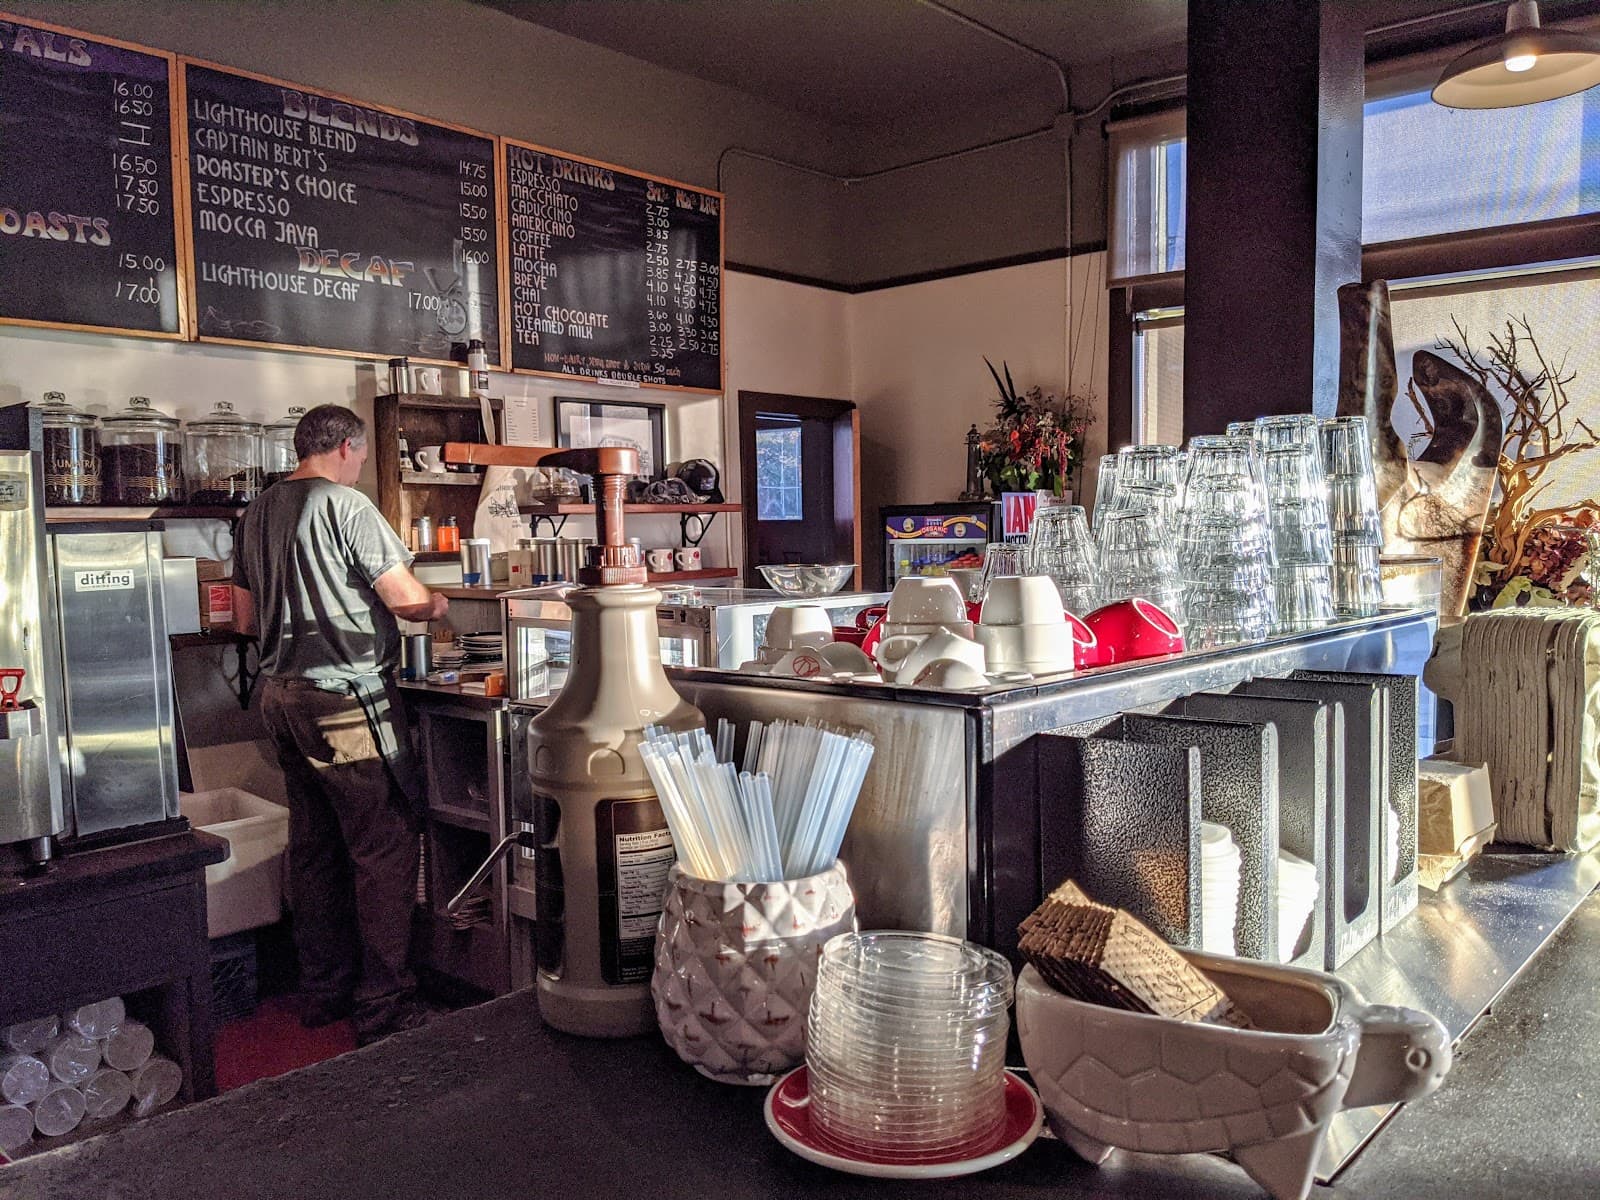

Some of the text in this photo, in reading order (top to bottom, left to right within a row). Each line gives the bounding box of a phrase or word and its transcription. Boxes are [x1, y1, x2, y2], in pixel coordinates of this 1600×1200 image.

[113, 79, 153, 98] 16.00
[114, 98, 153, 116] 16.50
[194, 99, 357, 153] LIGHTHOUSE BLEND
[281, 89, 419, 147] BLENDS
[195, 127, 328, 173] CAPTAIN BERT'S
[113, 153, 157, 175] 16.50
[460, 159, 487, 179] 14.75
[510, 146, 615, 192] HOT DRINKS
[196, 153, 357, 205] ROASTER'S CHOICE
[460, 181, 488, 198] 15.00
[511, 168, 560, 193] ESPRESSO
[197, 182, 290, 217] ESPRESSO
[511, 183, 578, 211] MACCHIATO
[460, 202, 487, 220] 15.50
[511, 198, 573, 224] CAPUCCINO
[647, 214, 670, 228] 3.00
[199, 209, 319, 248] MOCCA JAVA
[461, 226, 488, 242] 15.50
[511, 213, 576, 239] AMERICANO
[646, 227, 670, 240] 3.85
[512, 228, 551, 248] COFFEE
[119, 252, 165, 271] 15.00
[513, 242, 546, 261] LATTE
[295, 246, 415, 288] DECAF
[513, 256, 557, 278] MOCHA
[201, 262, 361, 302] LIGHTHOUSE DECAF
[514, 272, 547, 291] BREVE
[647, 266, 669, 280] 3.85
[699, 275, 719, 290] 4.50
[115, 277, 161, 304] 17.00
[408, 291, 439, 311] 17.00
[514, 286, 540, 302] CHAI
[646, 294, 666, 307] 4.10
[514, 301, 609, 328] HOT CHOCOLATE
[515, 315, 593, 339] STEAMED MILK
[516, 329, 540, 345] TEA
[649, 321, 671, 333] 3.00
[561, 364, 576, 375] ALL
[579, 366, 608, 379] DRINKS
[611, 370, 641, 382] DOUBLE
[643, 374, 667, 385] SHOTS
[81, 573, 130, 586] ditting
[619, 834, 652, 842] Nutrition
